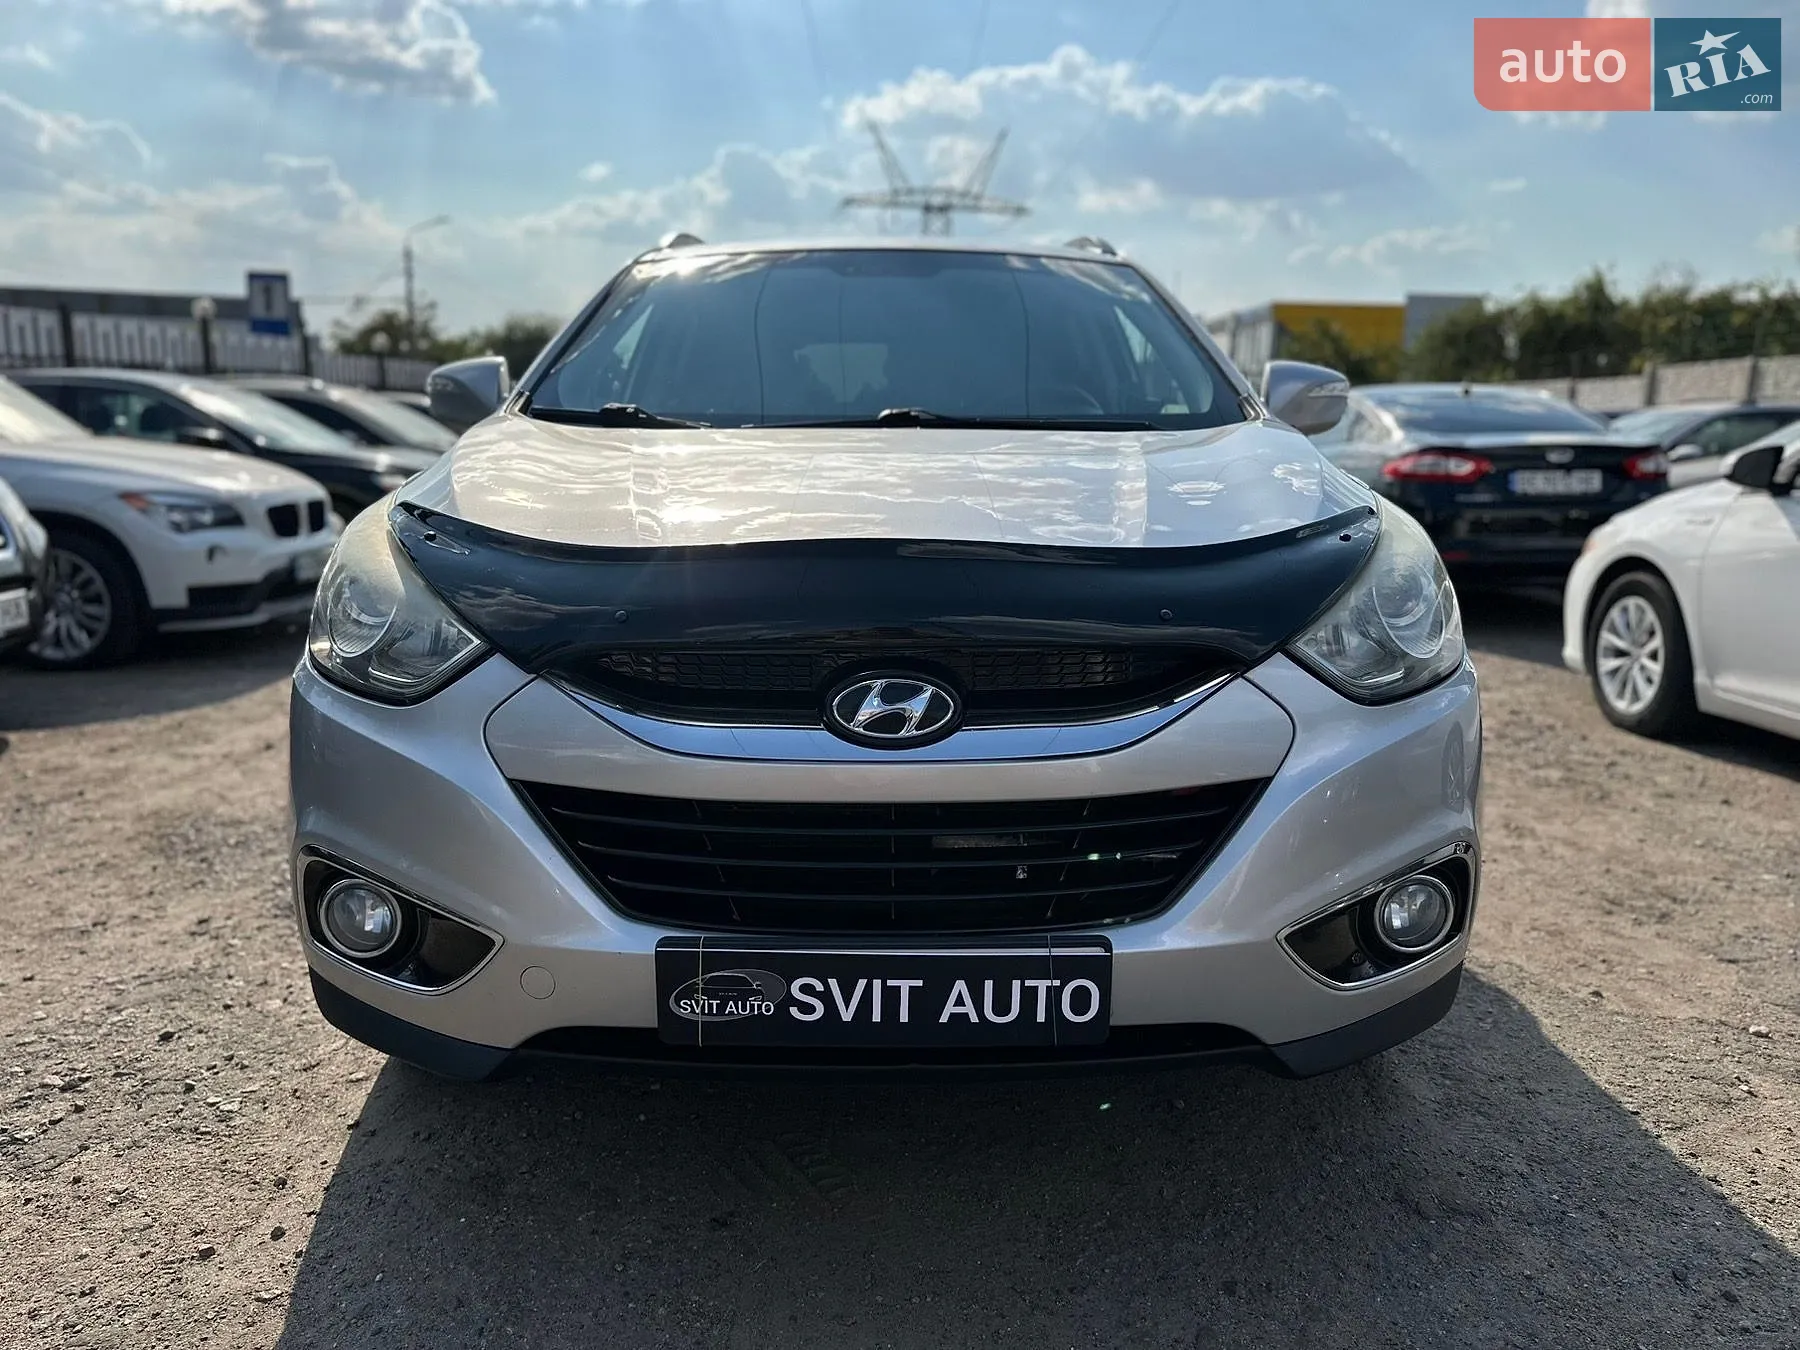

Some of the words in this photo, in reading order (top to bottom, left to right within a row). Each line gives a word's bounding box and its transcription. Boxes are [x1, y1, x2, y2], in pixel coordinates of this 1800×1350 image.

[679, 999, 721, 1014] SVIT
[724, 1000, 775, 1016] AUTO
[788, 976, 924, 1024] SVIT
[938, 978, 1101, 1024] AUTO
